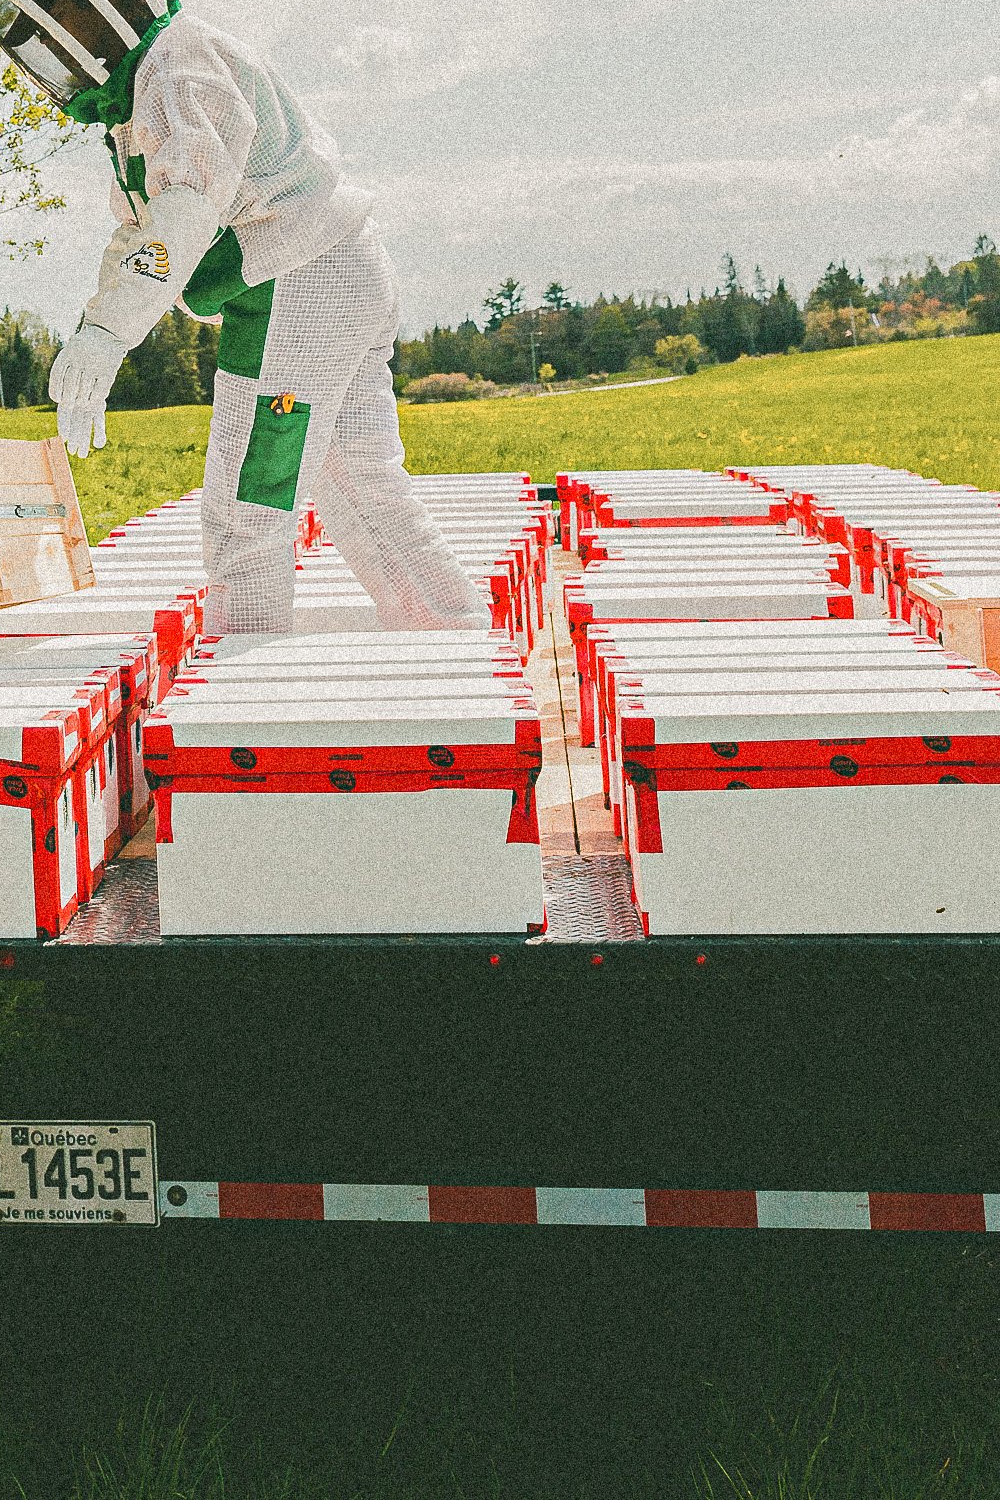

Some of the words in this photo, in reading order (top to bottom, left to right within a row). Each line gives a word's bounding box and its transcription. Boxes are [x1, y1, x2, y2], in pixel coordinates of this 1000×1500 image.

[30, 1129, 98, 1147] Québec
[4, 1206, 20, 1220] Je
[24, 1209, 45, 1220] me
[49, 1206, 113, 1220] souviens
